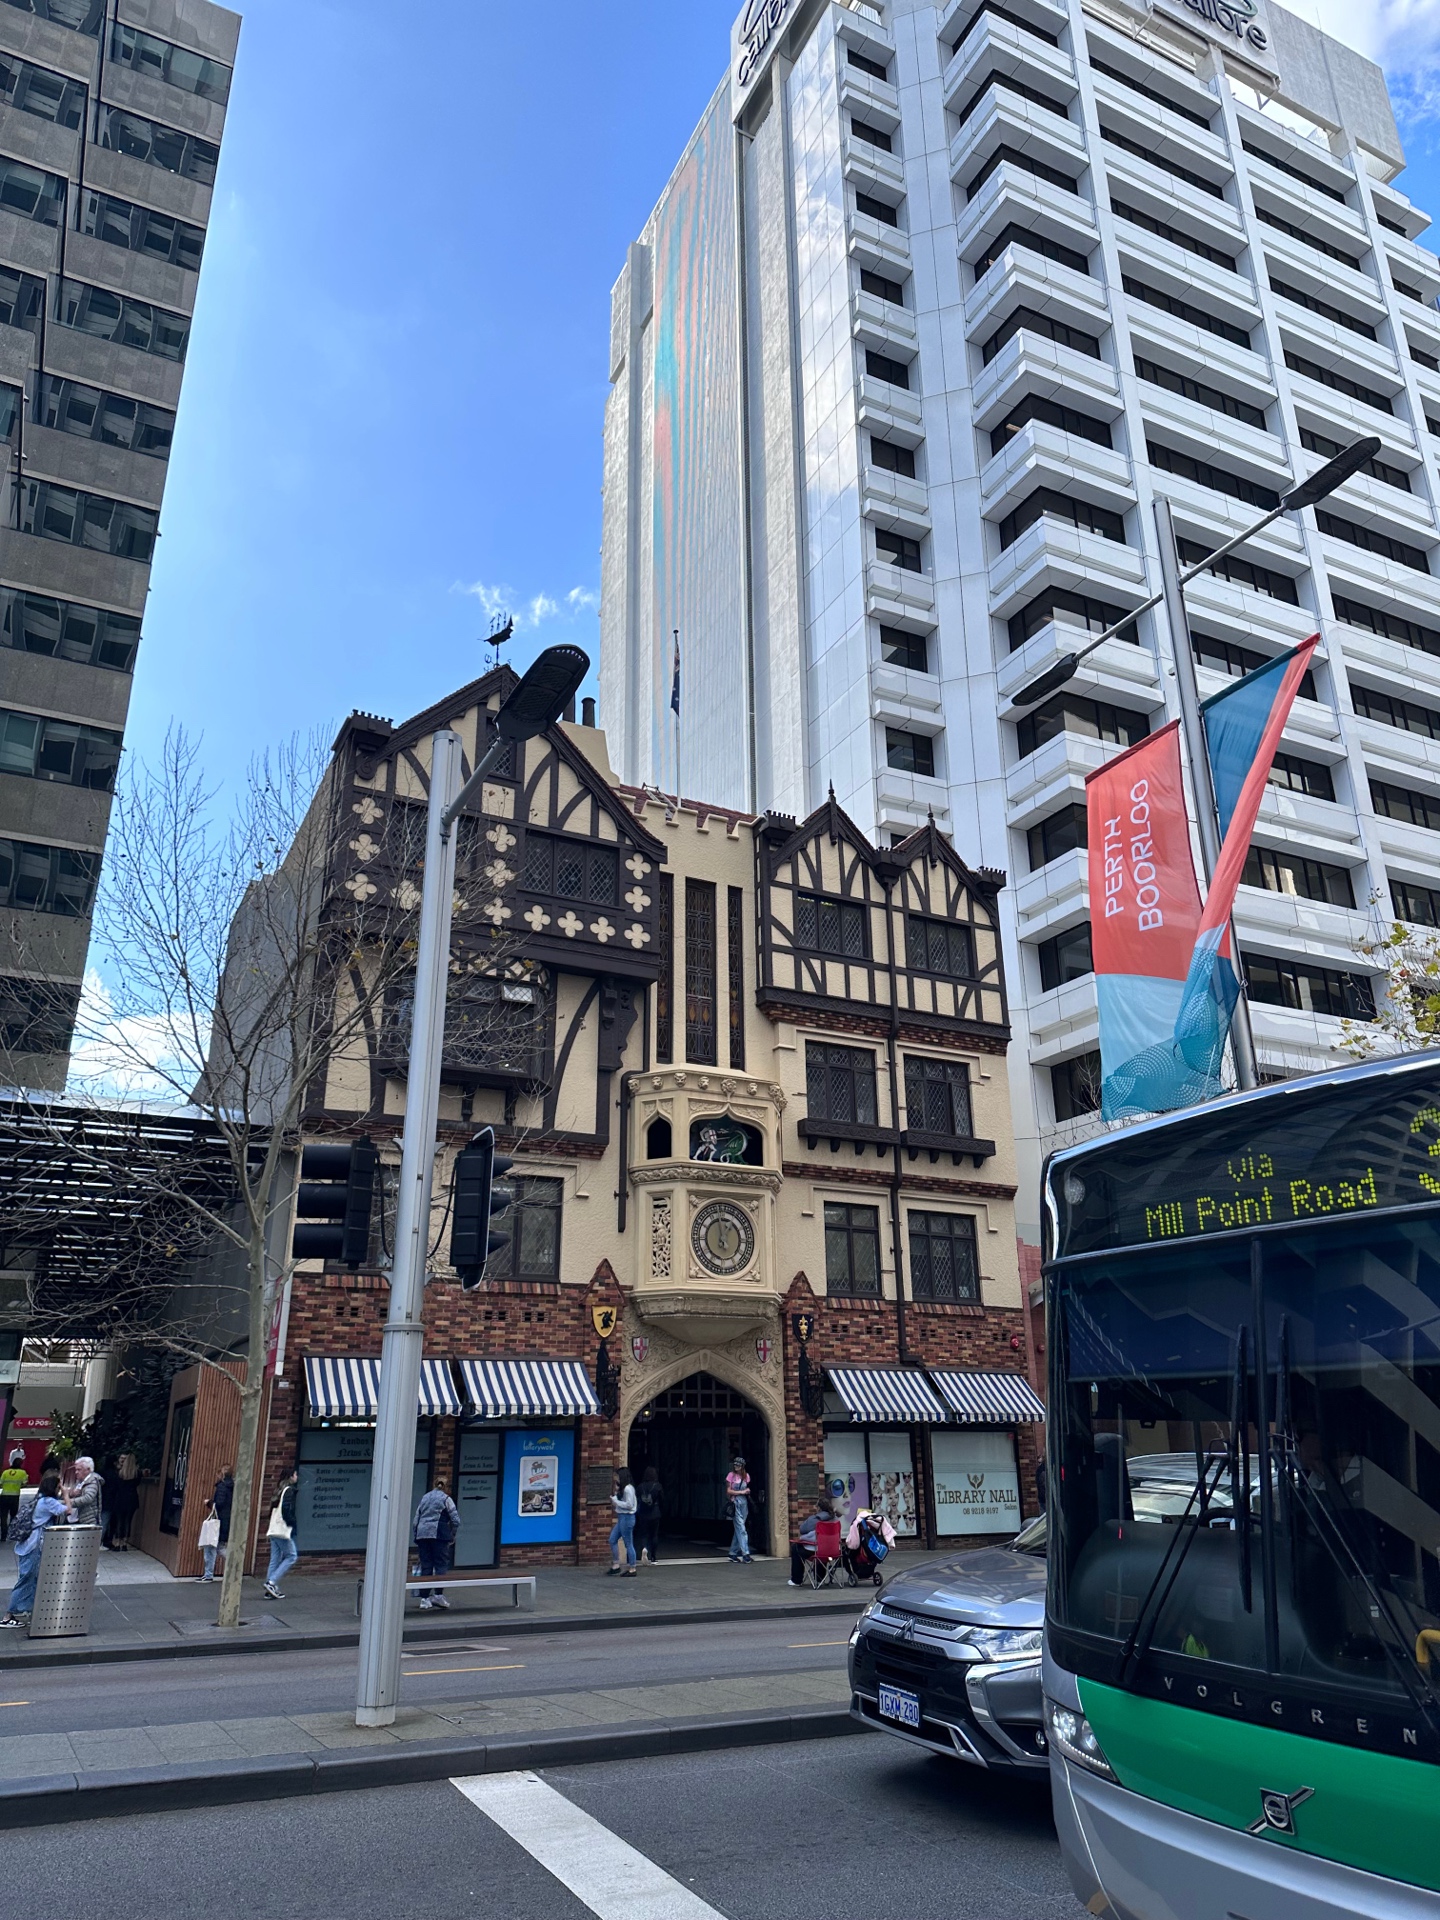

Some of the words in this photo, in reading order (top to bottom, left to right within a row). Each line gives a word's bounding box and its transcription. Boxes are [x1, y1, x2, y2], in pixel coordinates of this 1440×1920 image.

[1104, 815, 1124, 918] PERTH
[1130, 779, 1164, 931] BOORLOO
[1227, 1147, 1274, 1182] via
[1146, 1201, 1185, 1238] Mill
[1196, 1186, 1273, 1231] Point
[1290, 1167, 1378, 1216] Road
[523, 1439, 556, 1453] lotterywest
[937, 1489, 986, 1504] LIBRARY
[990, 1489, 1017, 1503] NAIL
[963, 1507, 971, 1515] 08
[1004, 1503, 1018, 1511] Salon
[1164, 1677, 1417, 1745] VOLGREN
